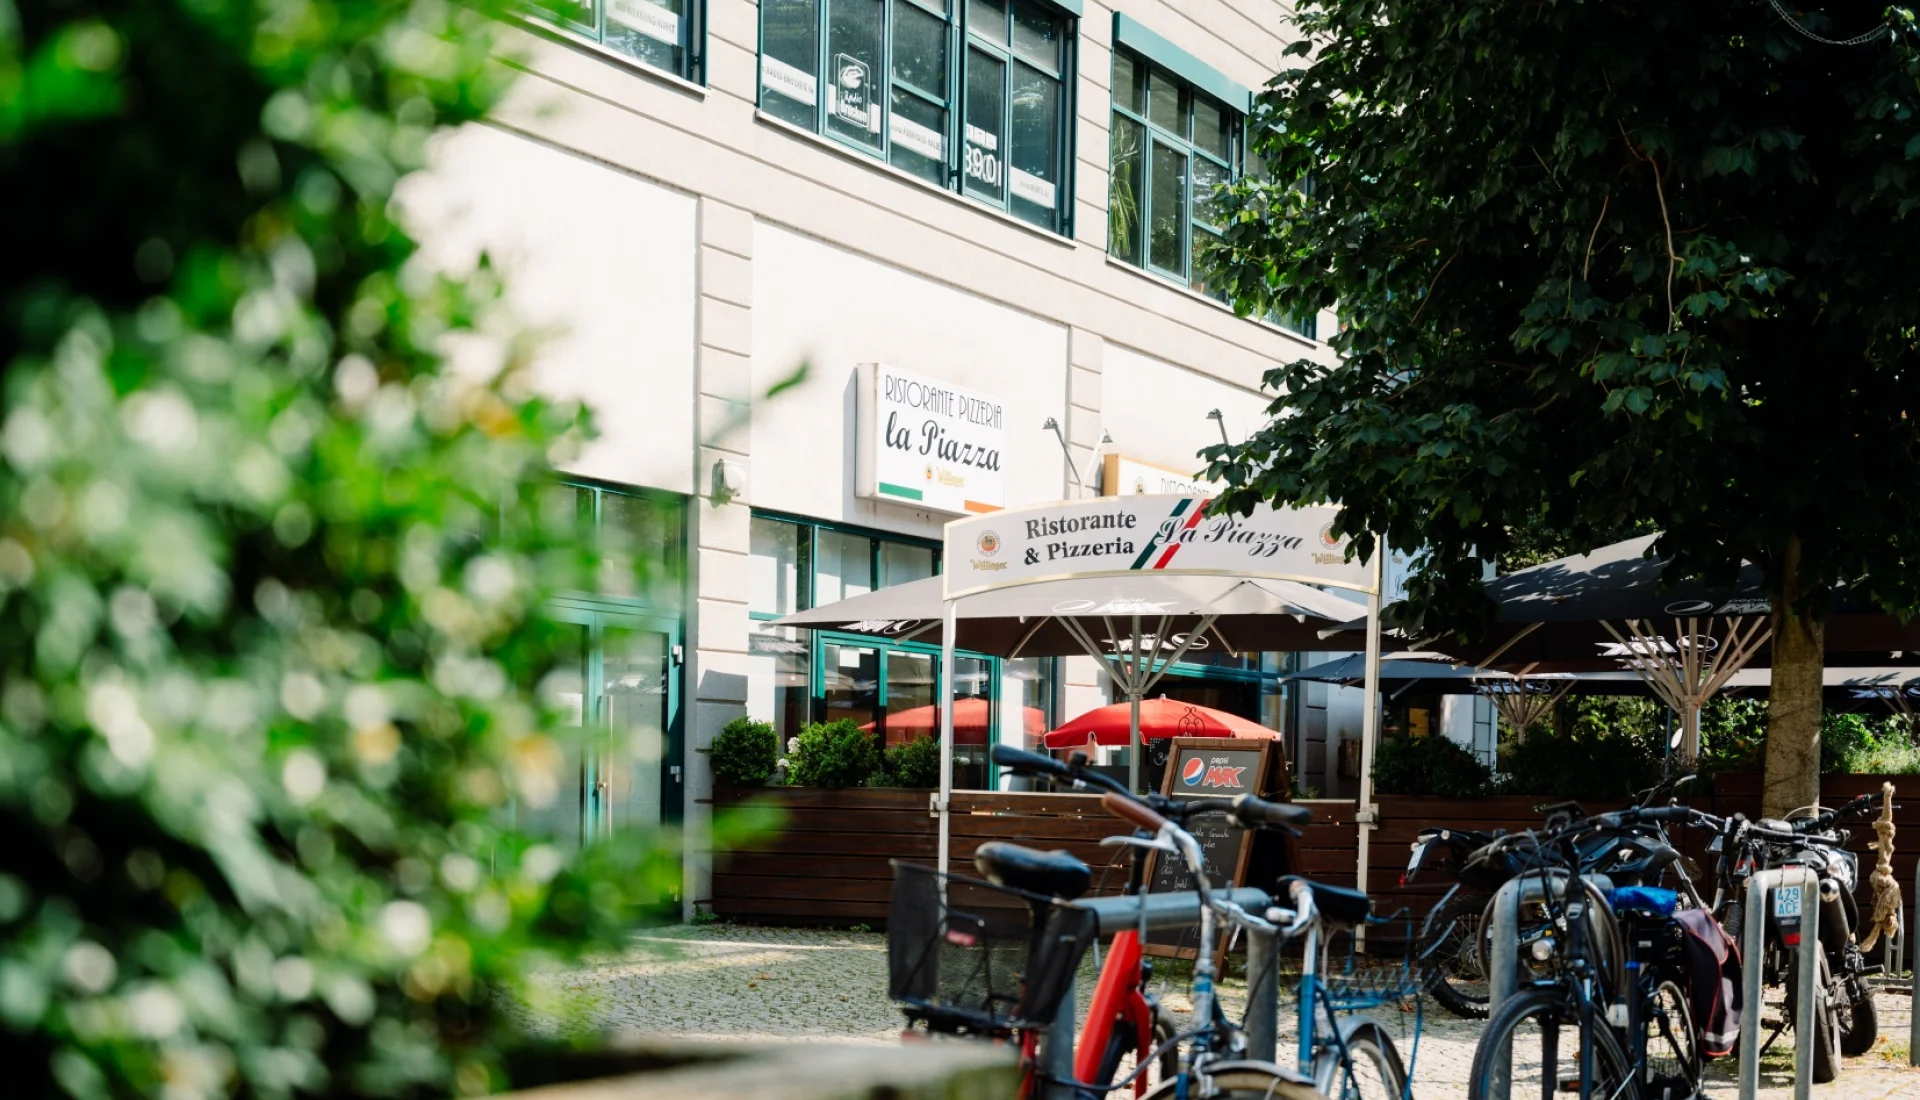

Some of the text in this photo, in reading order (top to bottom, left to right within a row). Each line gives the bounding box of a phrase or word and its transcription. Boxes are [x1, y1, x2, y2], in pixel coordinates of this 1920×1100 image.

[885, 374, 1002, 430] RISTORANTE PIZZERIA
[885, 410, 1001, 472] la Piazza
[1025, 509, 1137, 541] Ristorante
[1156, 516, 1199, 546] La
[1203, 517, 1305, 558] Piazza
[1023, 536, 1135, 566] & Pizzeria
[1210, 756, 1230, 766] pepsi
[1201, 765, 1248, 788] MAX
[1777, 887, 1799, 901] 429
[1778, 901, 1798, 915] ACF
